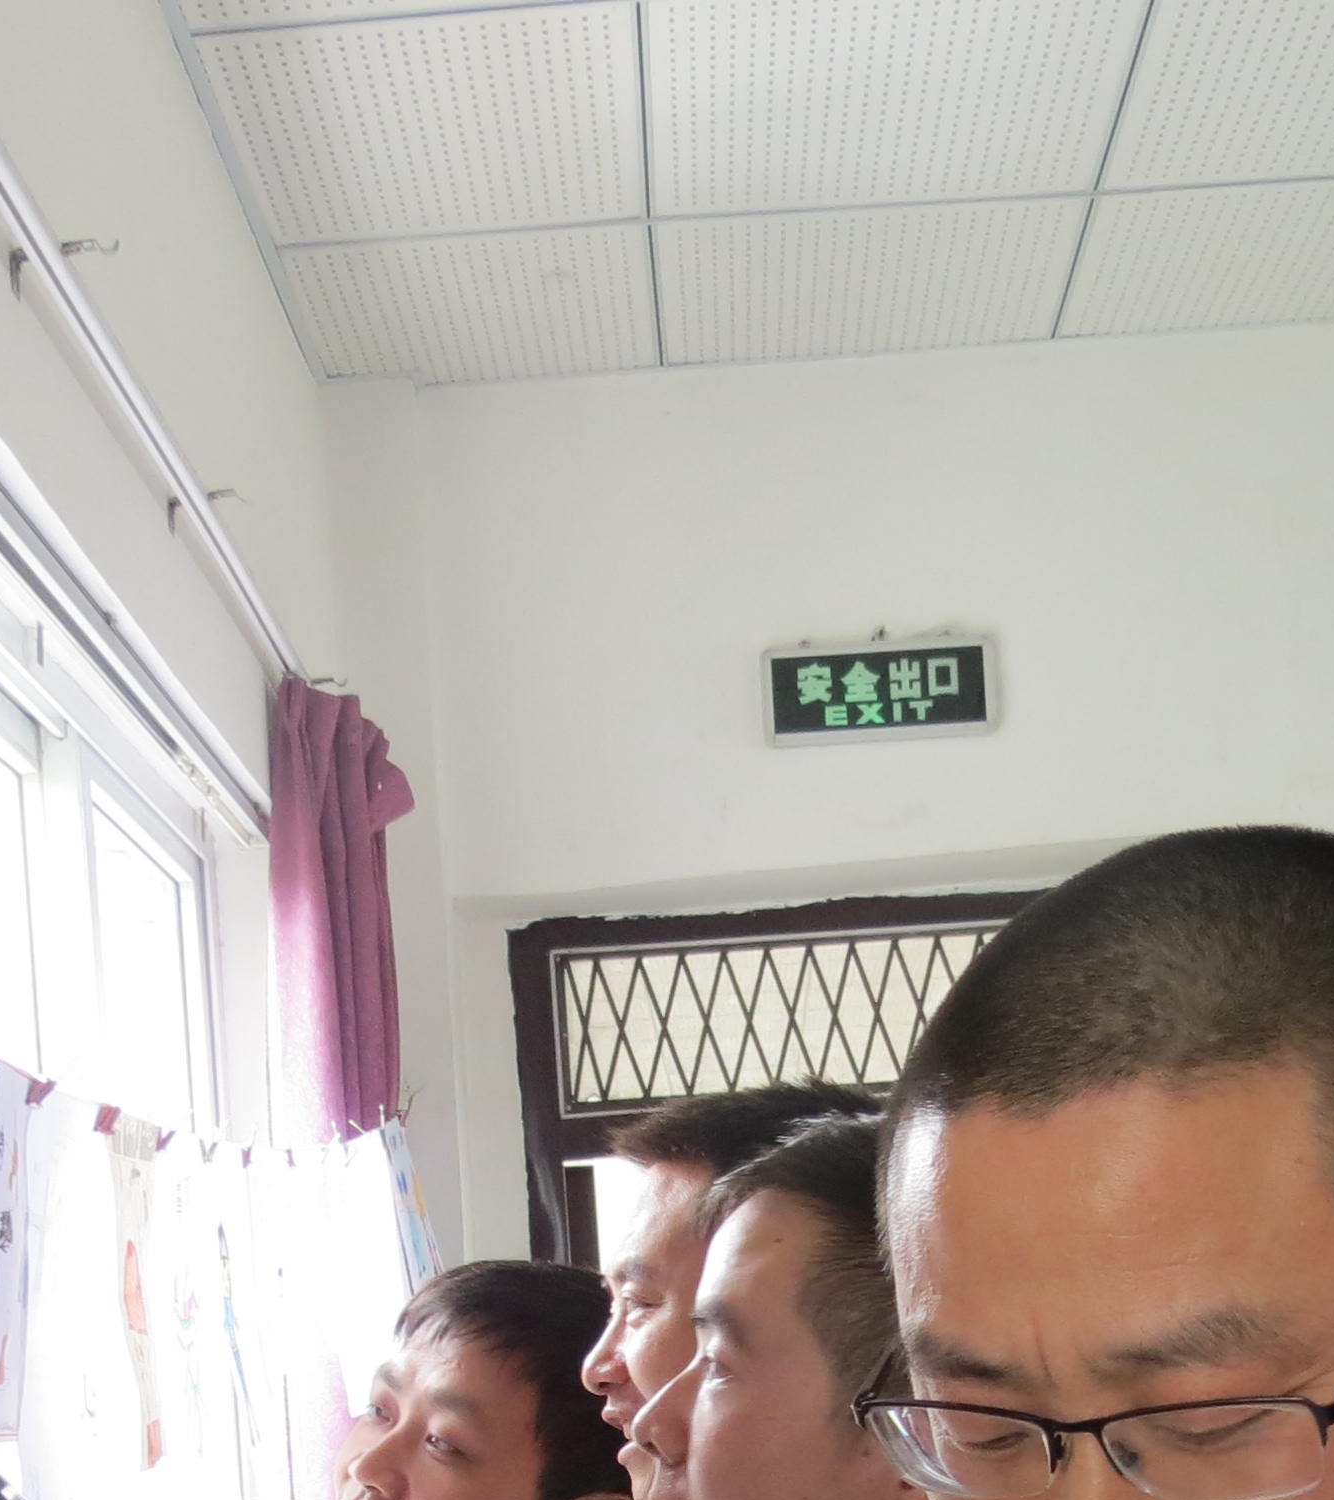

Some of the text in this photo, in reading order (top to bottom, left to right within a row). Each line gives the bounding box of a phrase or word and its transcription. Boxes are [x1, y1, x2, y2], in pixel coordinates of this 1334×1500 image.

[796, 656, 960, 706] 安全出口
[824, 699, 934, 727] EXIT
